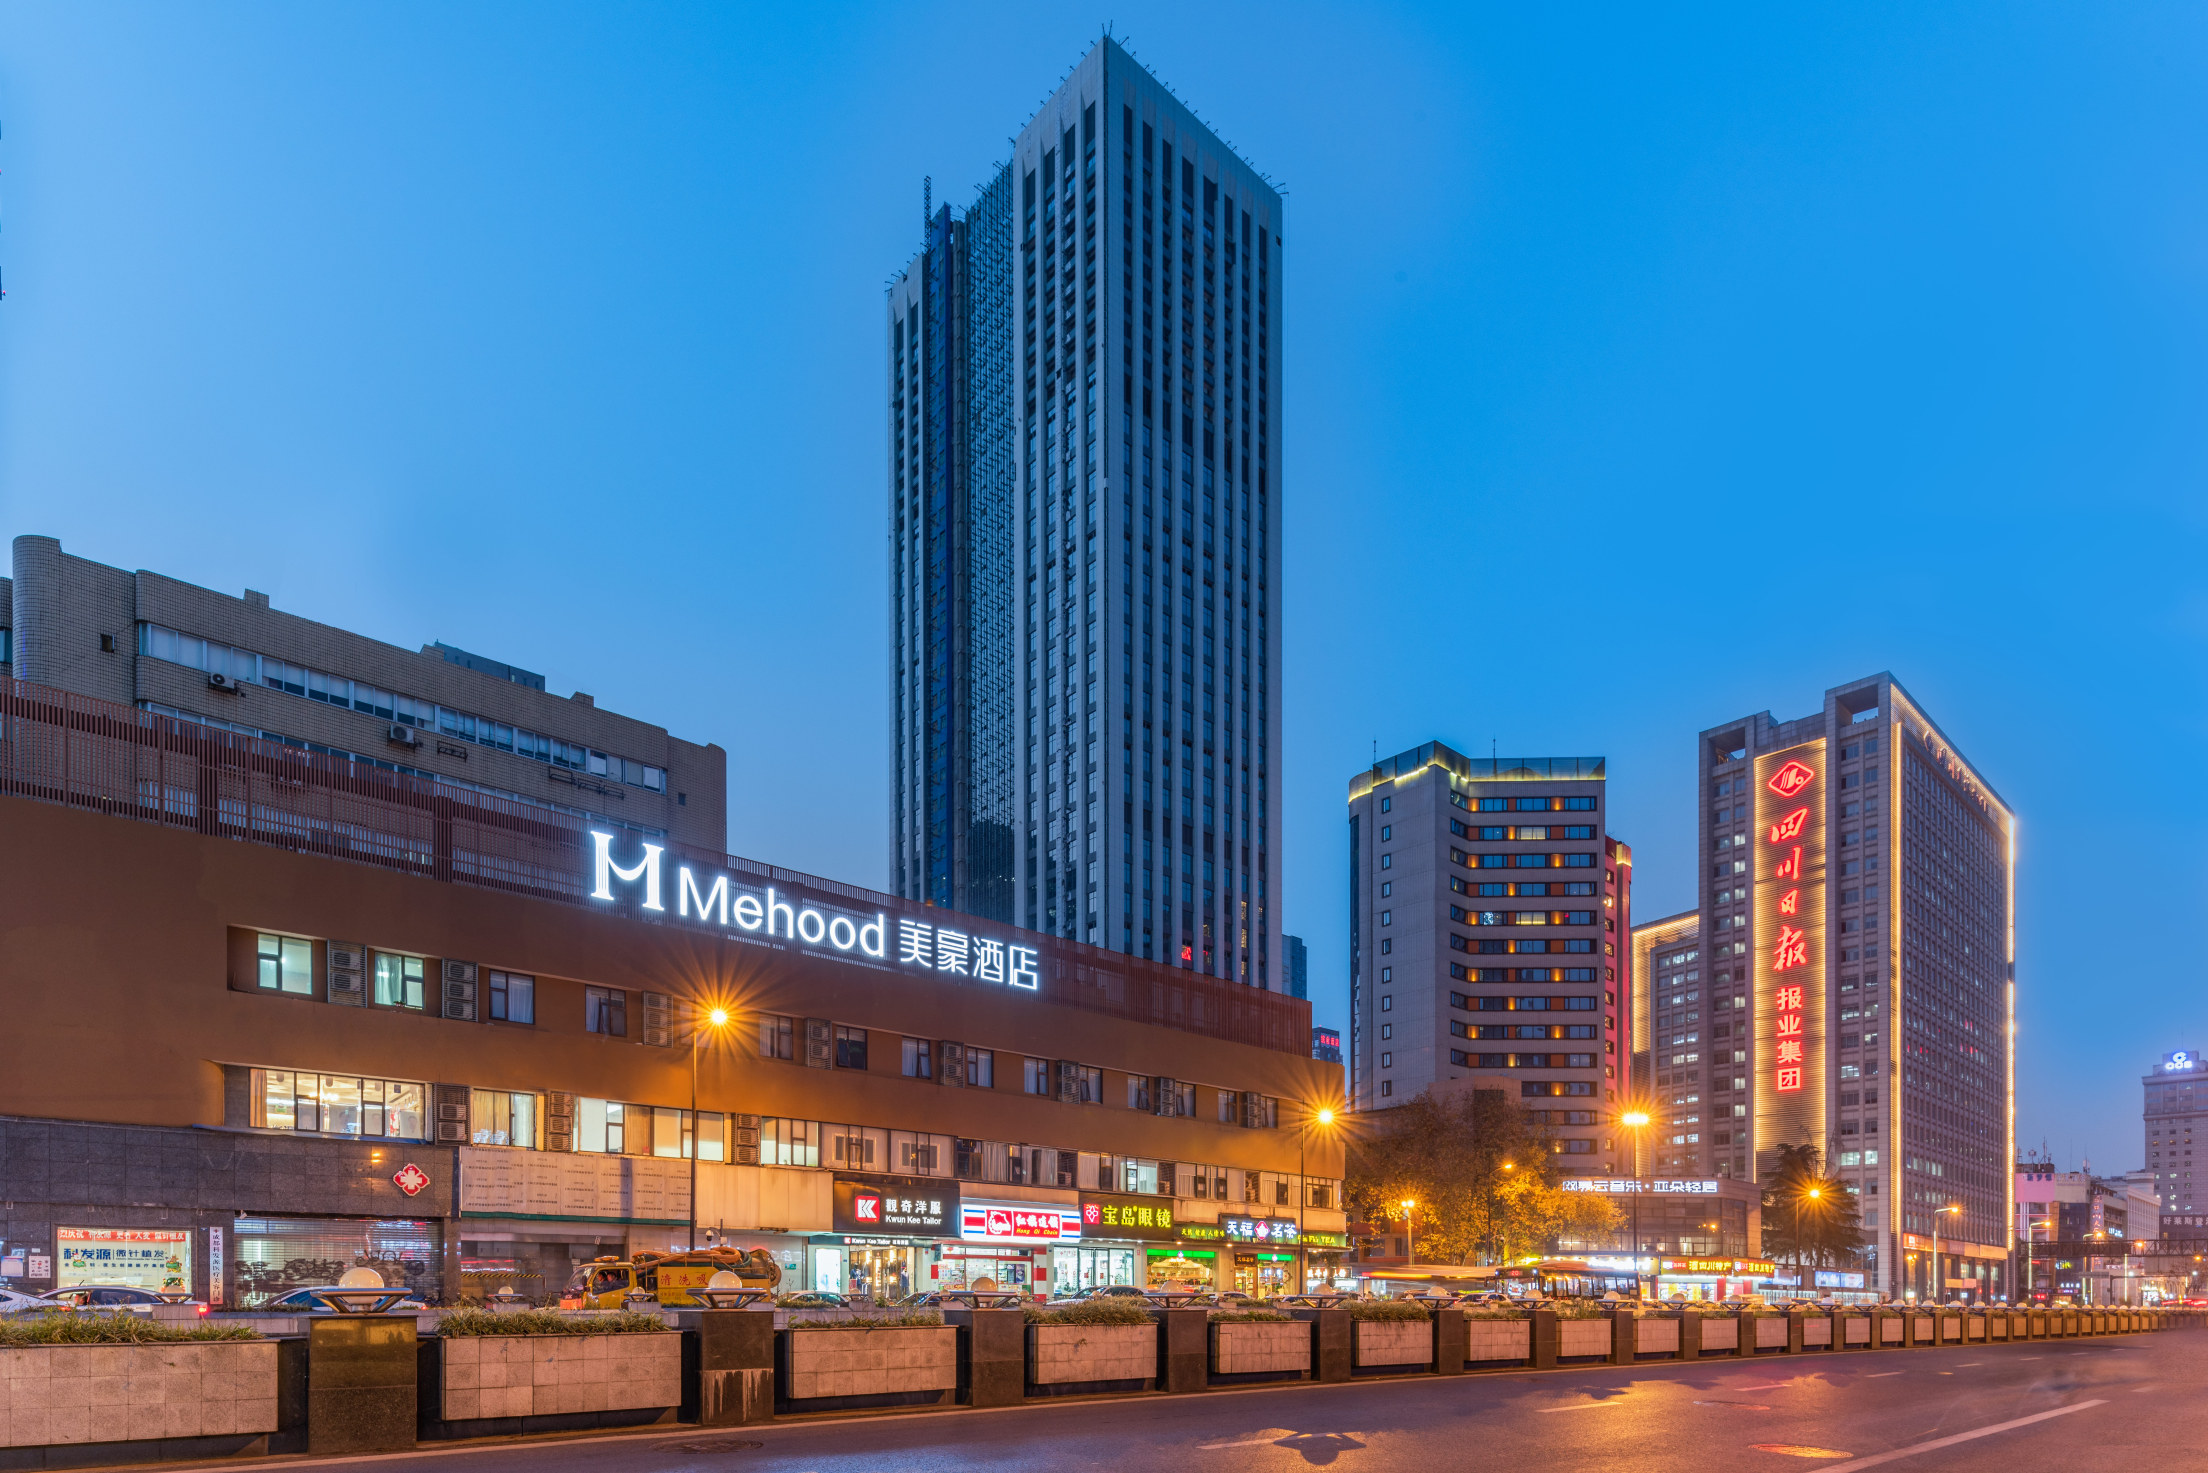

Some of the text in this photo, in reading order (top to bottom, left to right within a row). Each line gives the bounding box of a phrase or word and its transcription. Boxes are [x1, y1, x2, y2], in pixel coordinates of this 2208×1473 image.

[679, 867, 885, 958] Mehood
[900, 919, 1038, 990] 美豪酒店
[1770, 807, 1808, 1091] 四川日报 报业集团
[885, 1199, 942, 1214] 觀奇洋服
[1102, 1205, 1171, 1228] 宝岛眼镜
[885, 1215, 942, 1225] Kwun Kee Tailor
[1226, 1221, 1297, 1239] 天福 茗茶
[1320, 1236, 1336, 1244] TEA
